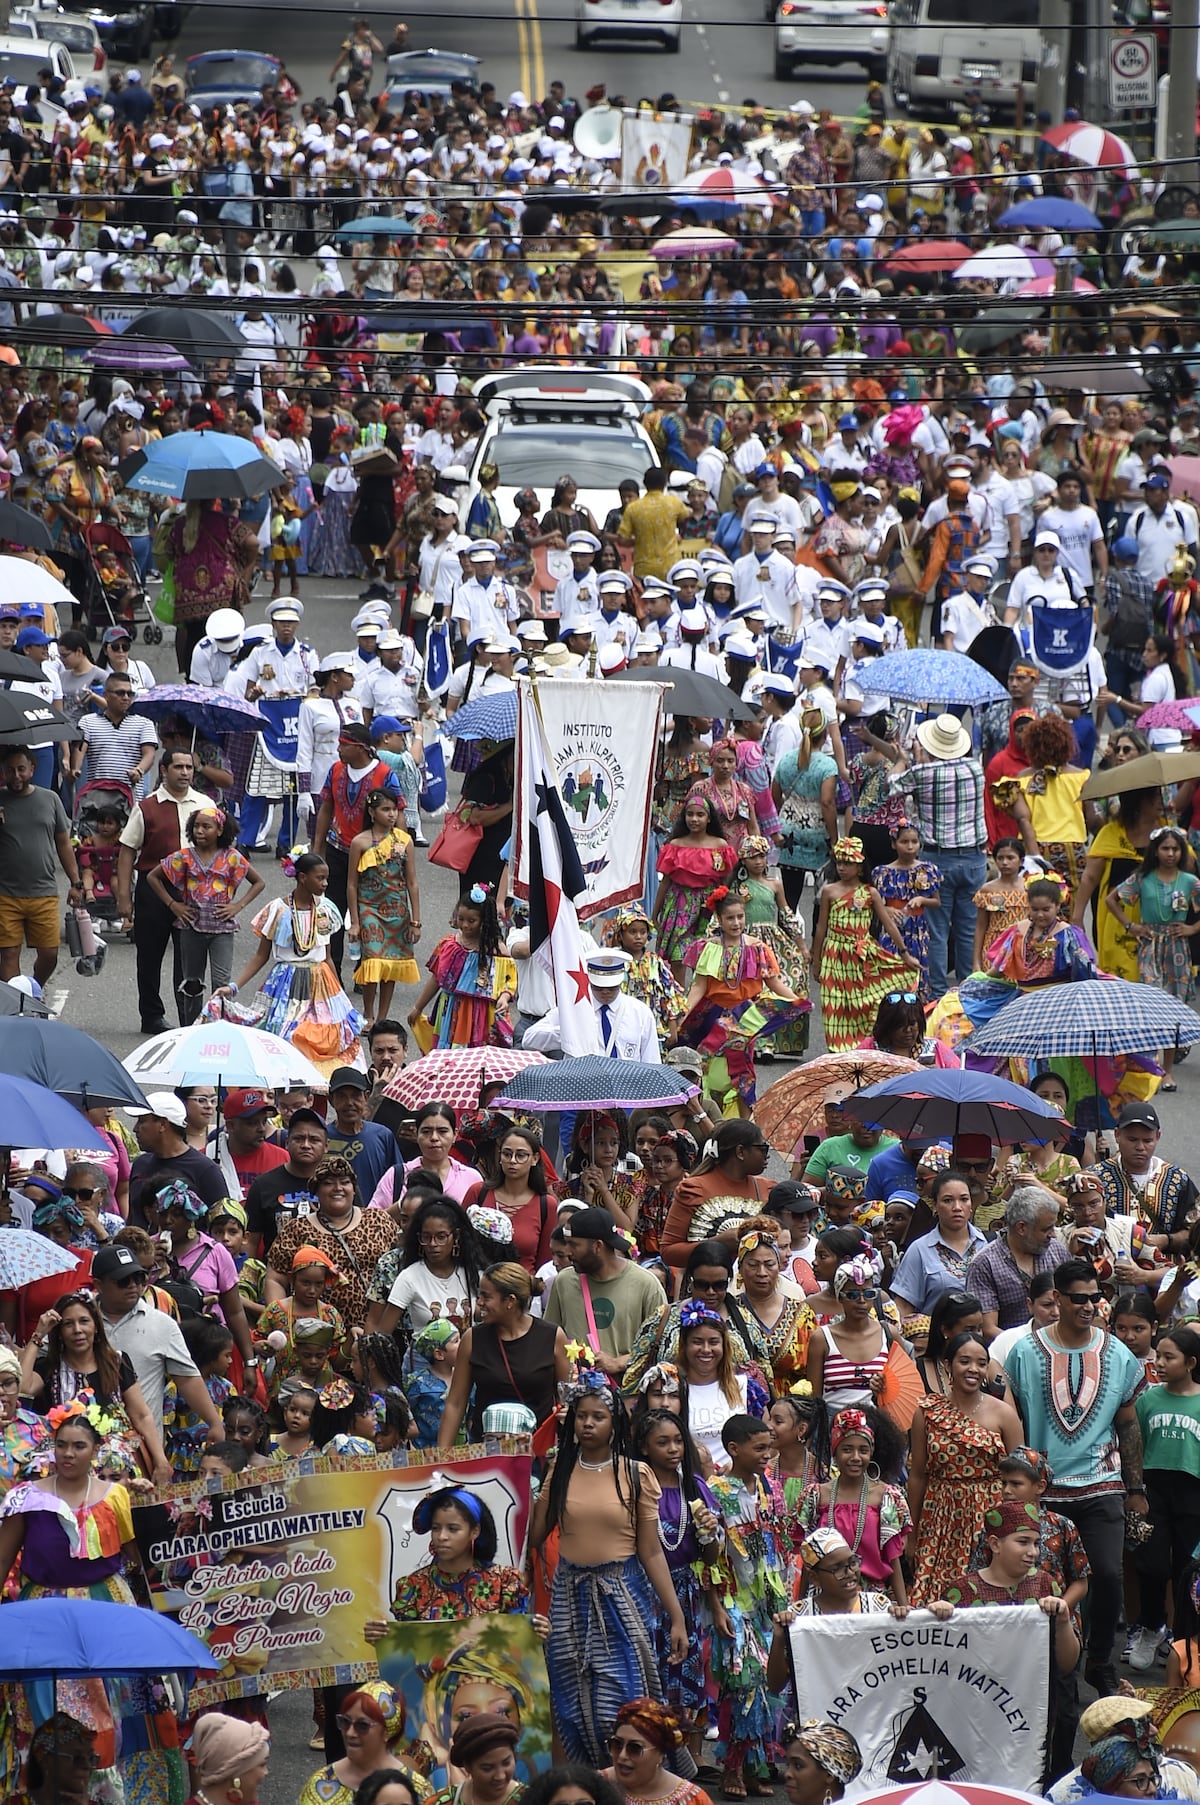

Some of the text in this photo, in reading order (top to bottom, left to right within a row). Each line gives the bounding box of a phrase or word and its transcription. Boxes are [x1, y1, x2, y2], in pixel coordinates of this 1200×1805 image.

[1052, 629, 1068, 647] K
[772, 656, 789, 672] K
[283, 717, 299, 736] K
[563, 723, 612, 738] INSTITUTO
[590, 740, 625, 791] KILPATRICK
[1149, 1413, 1174, 1434] NEW
[150, 1509, 365, 1563] CLARA OPHELIA WATTLEY
[400, 1530, 414, 1549] CLA
[186, 1549, 336, 1597] Felicita a toda
[179, 1582, 354, 1635] La Etnia Negra
[211, 1642, 233, 1659] en
[870, 1628, 968, 1654] ESCUELA
[826, 1657, 1031, 1734] ARA OPHELIA WATTLEY
[913, 1686, 928, 1705] S
